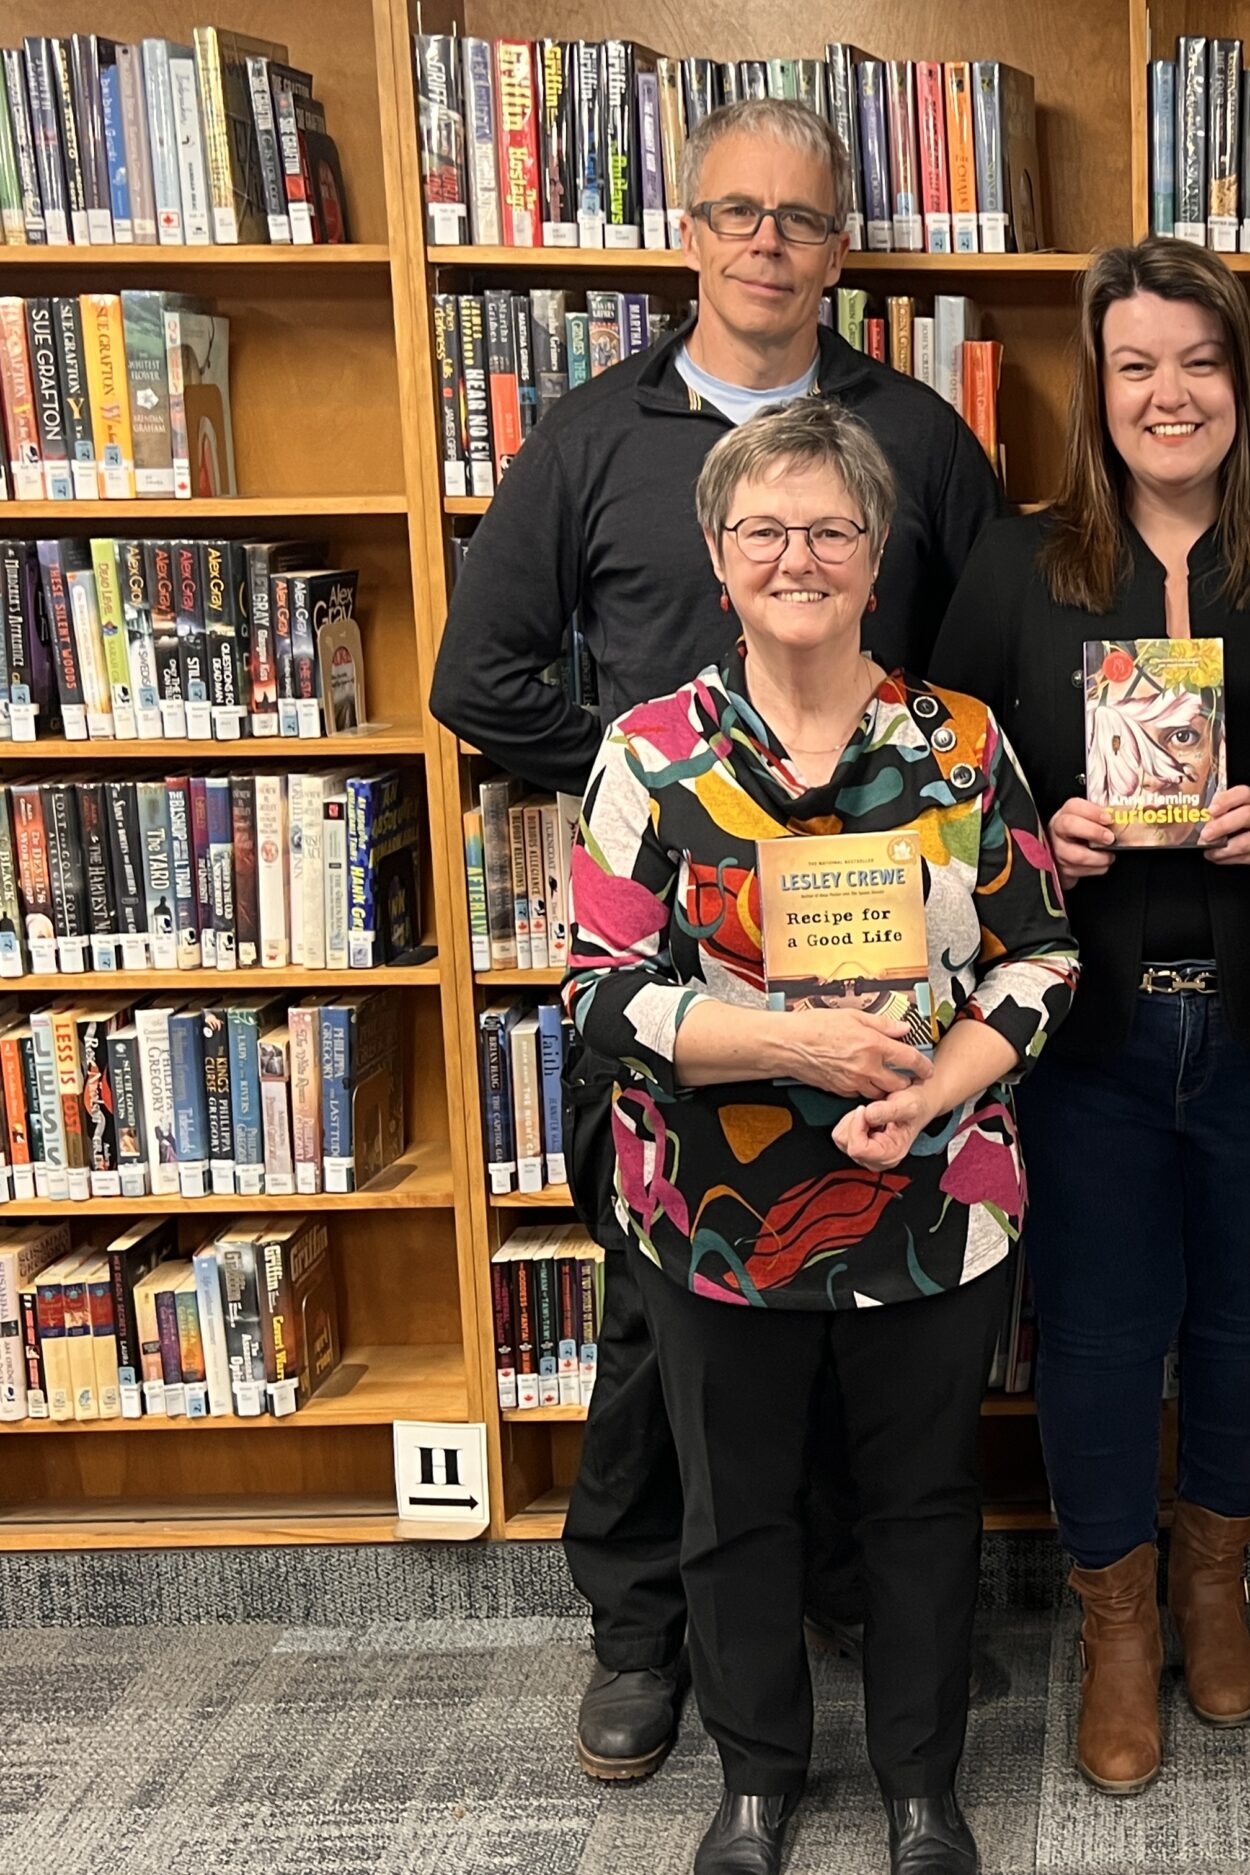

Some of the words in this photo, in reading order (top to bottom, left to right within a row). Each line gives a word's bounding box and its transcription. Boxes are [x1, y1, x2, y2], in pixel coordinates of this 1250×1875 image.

[545, 46, 562, 107] Griffin
[581, 46, 598, 99] Griffin
[608, 41, 627, 106] Griffin
[32, 309, 52, 346] SUE
[460, 301, 474, 365] GRIPPANDO
[471, 301, 482, 339] JAMES
[488, 303, 497, 342] Grimes
[499, 303, 509, 342] Martha
[518, 312, 527, 347] MARTHA
[572, 320, 584, 355] GRIMES
[629, 304, 642, 345] MARTHA
[129, 360, 161, 370] WHITEST
[520, 349, 529, 380] GRIMES
[550, 336, 560, 371] Grimes
[131, 370, 161, 381] FLOWER
[465, 369, 486, 410] HEAR
[37, 350, 62, 441] GRAFTON
[133, 414, 164, 424] BRENDAN
[133, 423, 166, 433] GRAHAM
[469, 415, 488, 437] NO
[49, 563, 64, 597] THESE
[330, 585, 354, 604] Alex
[53, 604, 70, 643] SILENT
[63, 648, 77, 689] WOODS
[56, 794, 66, 829] LOST
[1147, 792, 1200, 806] Fleming
[512, 816, 522, 844] BLOODY
[545, 821, 556, 870] TURNCOAT
[0, 851, 15, 901] BLACK
[31, 848, 46, 904] DEVIL'S
[149, 853, 169, 890] YARD
[351, 866, 364, 904] HANK
[514, 847, 524, 888] RELATIONS
[530, 851, 540, 895] ALLEGIANCE
[780, 872, 841, 891] LESLEY
[847, 868, 906, 887] CREWE
[786, 910, 853, 925] Recipe
[861, 908, 891, 920] for
[787, 938, 797, 948] a
[807, 933, 853, 947] Good
[863, 930, 902, 944] Life
[56, 1024, 73, 1062] LESS
[322, 1022, 334, 1080] GREGORY
[333, 1028, 345, 1078] PHILIPPA
[542, 1034, 560, 1076] faith
[60, 1071, 76, 1085] IS
[148, 1047, 163, 1113] GREGORY
[205, 1056, 216, 1092] CURSE
[208, 1097, 220, 1154] GREGORY
[220, 1100, 231, 1151] PHILIPPA
[265, 1245, 282, 1291] Griffin
[519, 1270, 527, 1306] GODDESS
[414, 1446, 465, 1486] H
